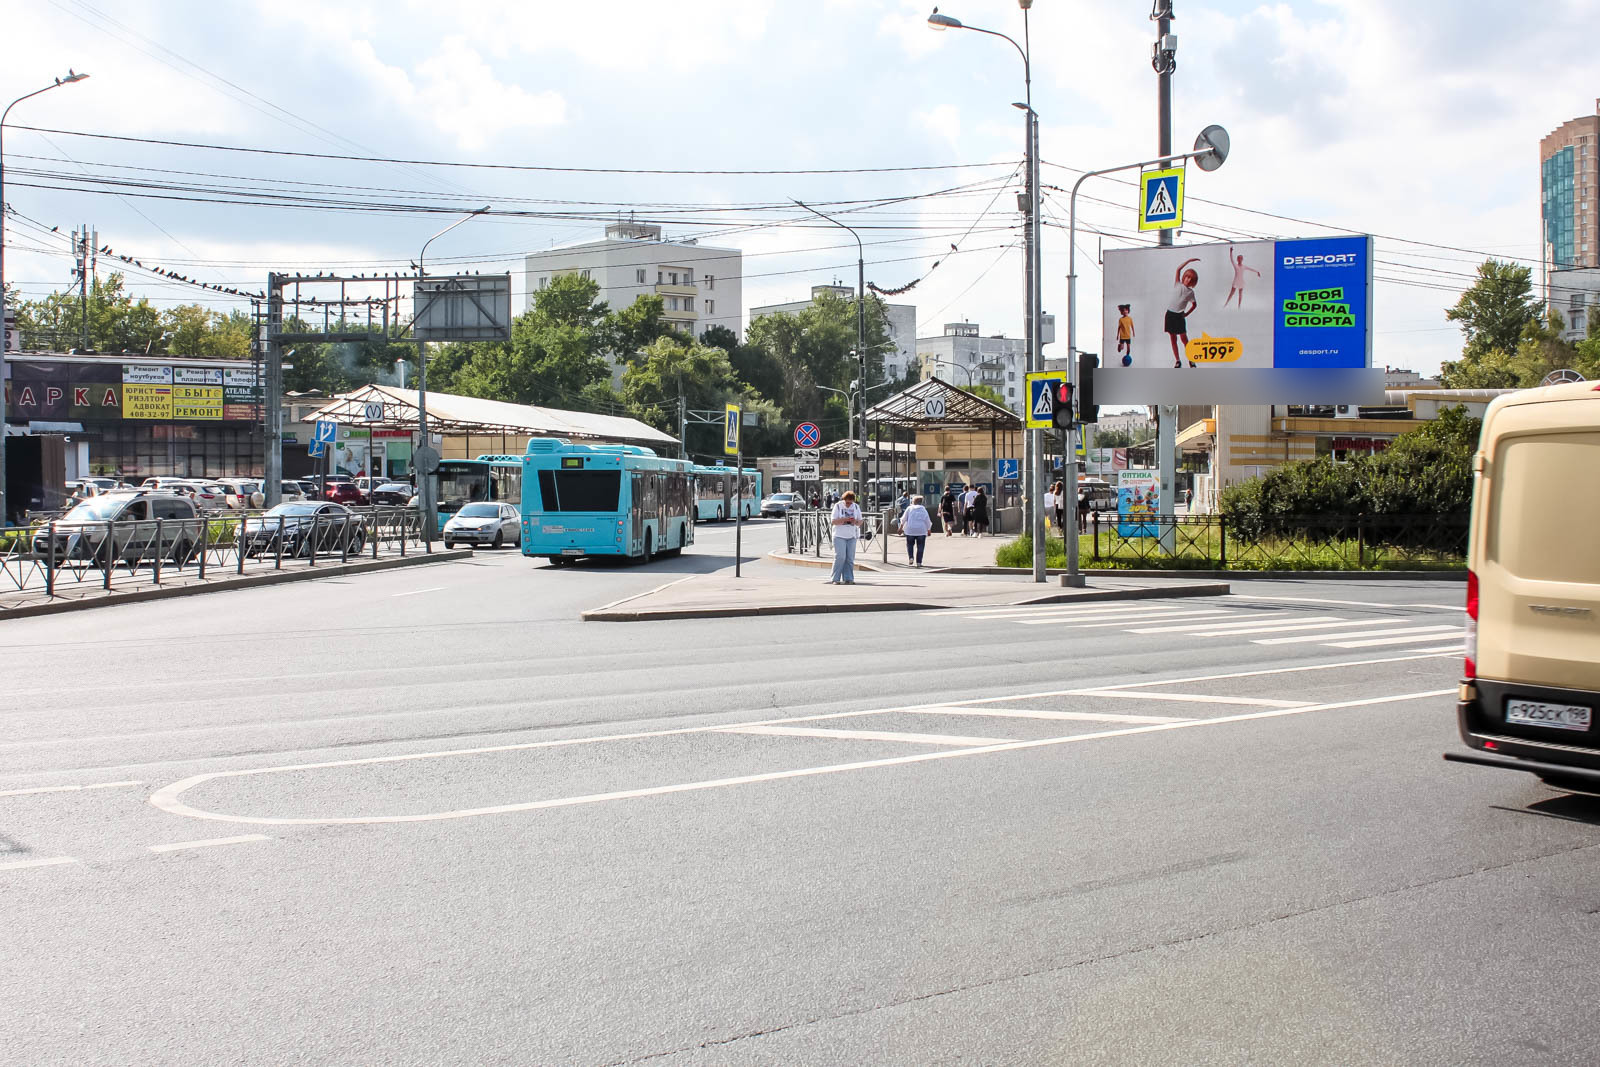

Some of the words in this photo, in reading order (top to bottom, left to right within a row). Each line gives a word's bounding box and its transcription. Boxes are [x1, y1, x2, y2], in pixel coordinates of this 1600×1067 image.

[1283, 253, 1357, 265] DESPORT
[1298, 289, 1341, 301] ТВОЯ
[1285, 302, 1347, 314] ФОРМА
[1286, 317, 1353, 326] СПОРТА
[185, 389, 213, 397] БЫТ
[133, 403, 171, 411] АДВОКАТ
[176, 408, 221, 417] РЕМОНТ
